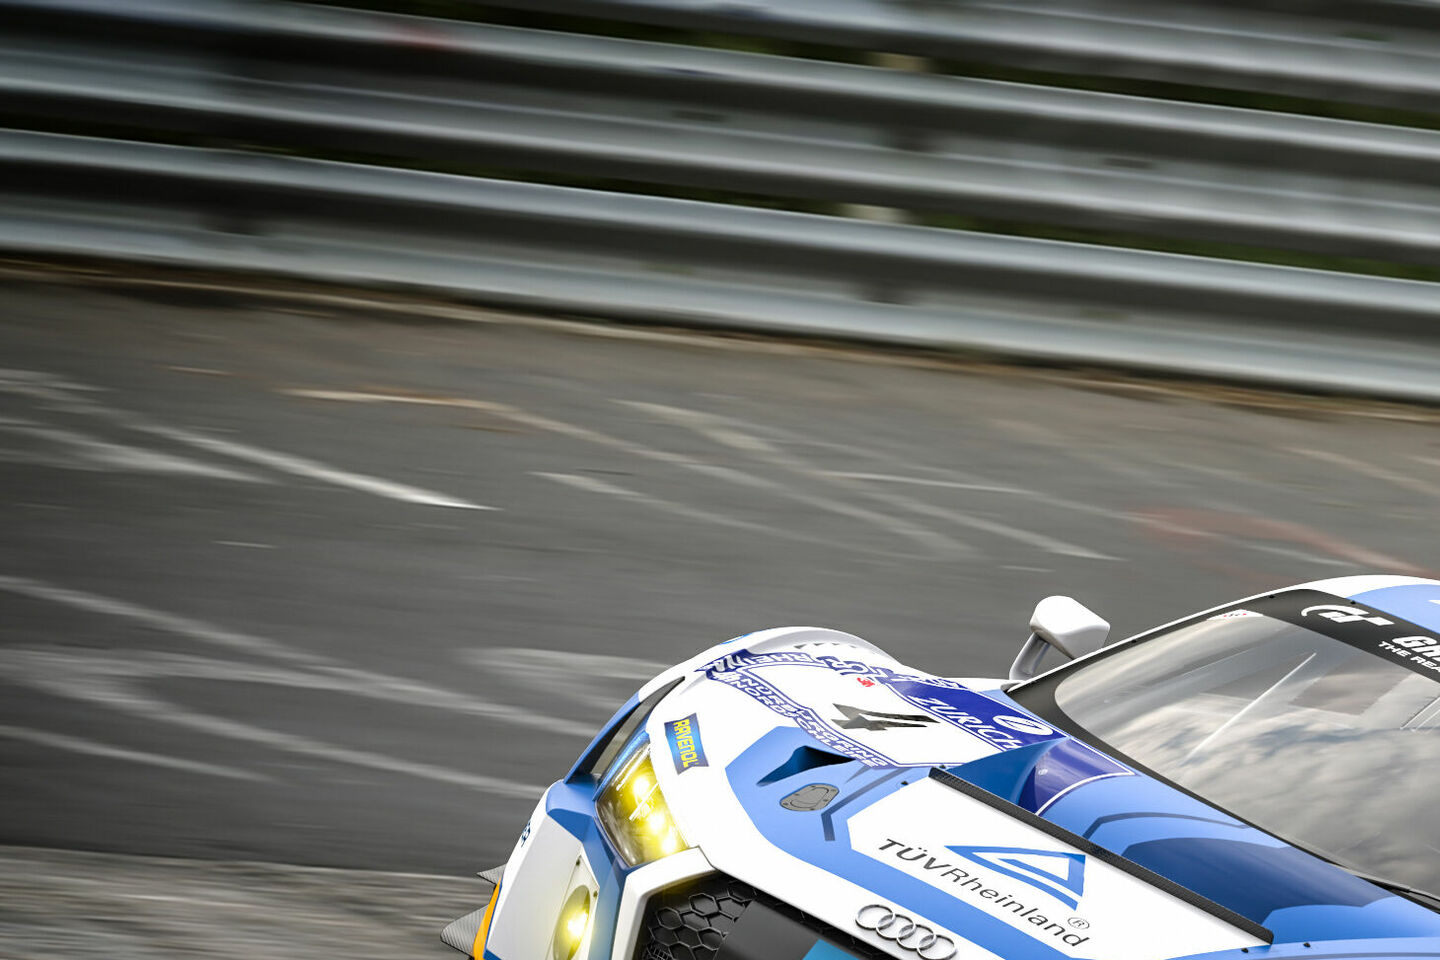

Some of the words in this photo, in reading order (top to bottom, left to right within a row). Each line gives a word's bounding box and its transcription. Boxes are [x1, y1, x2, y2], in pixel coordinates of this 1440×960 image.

[1378, 641, 1411, 658] THE
[831, 703, 941, 731] 4
[673, 719, 698, 768] RAVENOL
